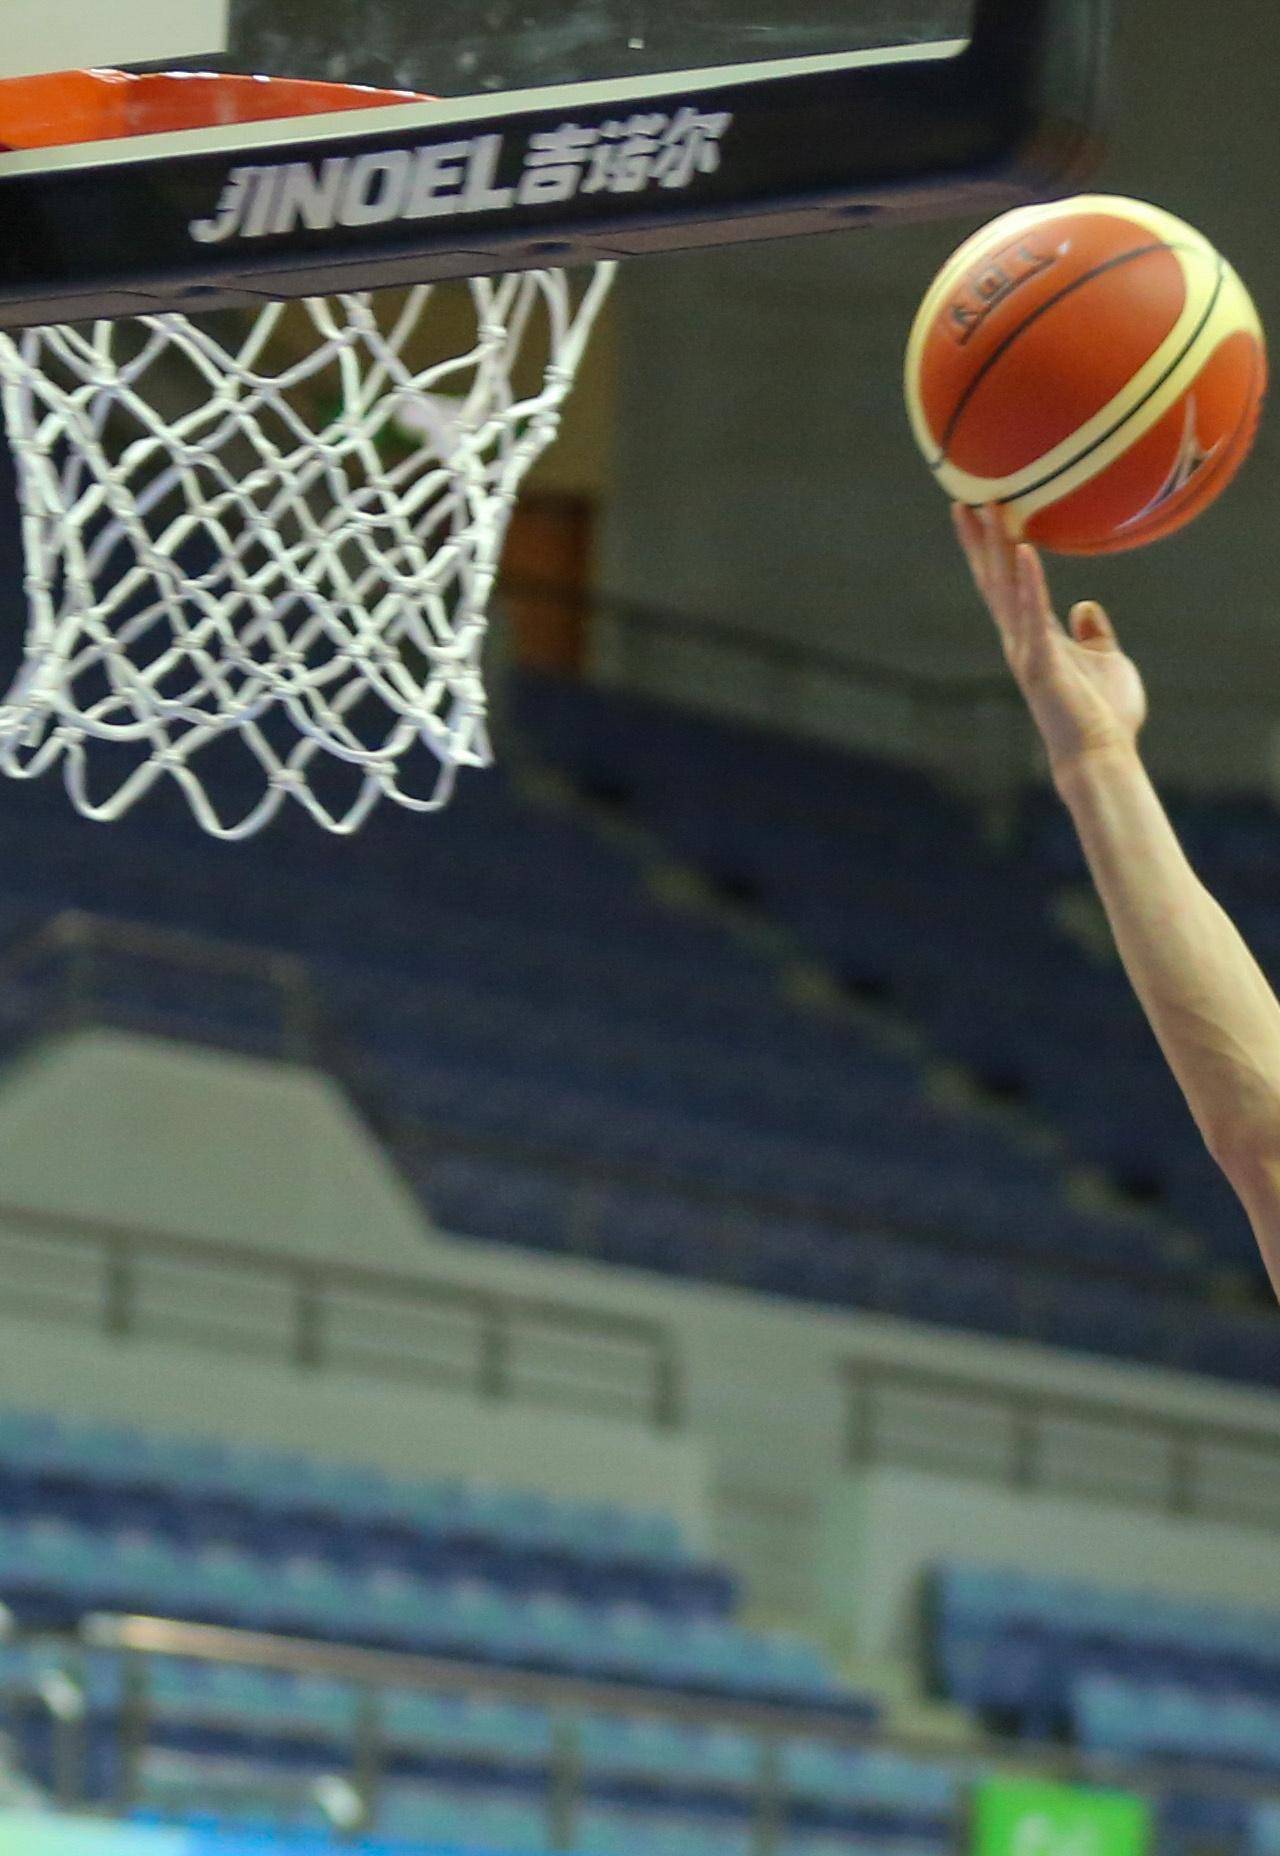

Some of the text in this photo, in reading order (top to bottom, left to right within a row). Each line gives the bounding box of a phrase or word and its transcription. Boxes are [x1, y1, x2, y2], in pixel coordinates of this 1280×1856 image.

[189, 106, 733, 243] JINOEL 吉诺尔
